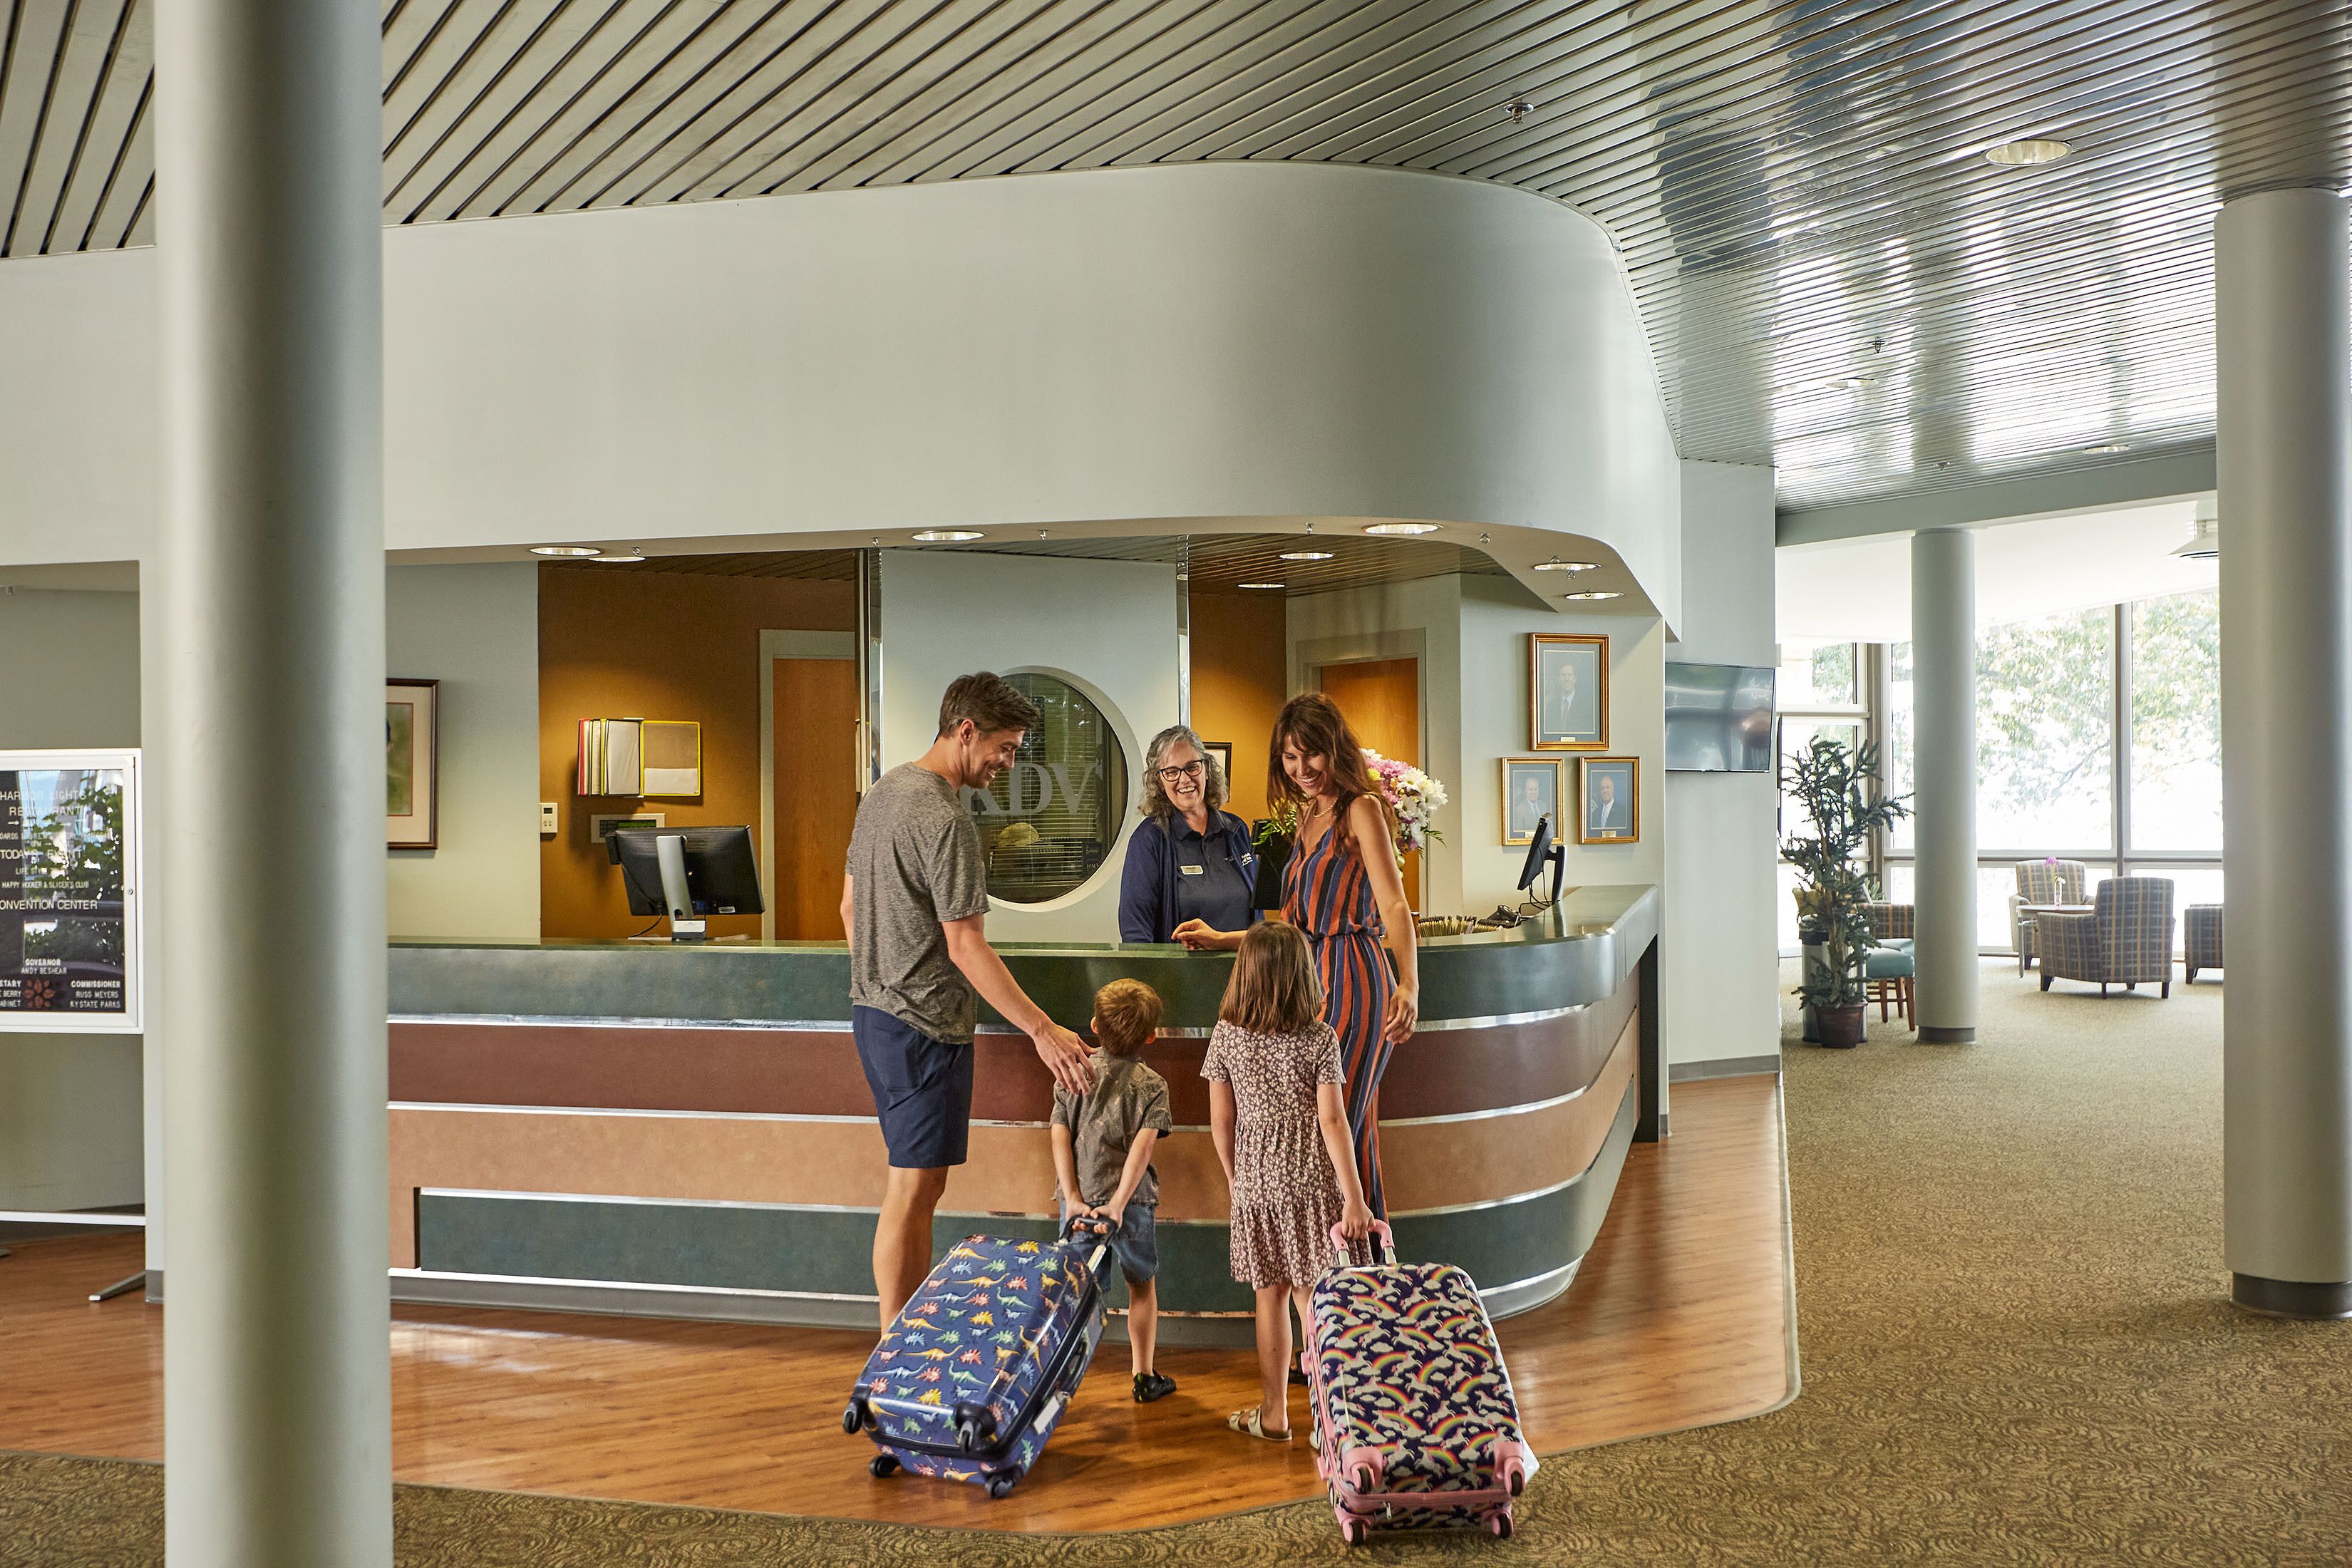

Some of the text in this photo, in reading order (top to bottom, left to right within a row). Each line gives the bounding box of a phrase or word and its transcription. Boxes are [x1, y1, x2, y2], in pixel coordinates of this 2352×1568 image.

[9, 806, 81, 817] RERANT
[47, 849, 82, 859] EVNT
[57, 899, 98, 909] CENTER
